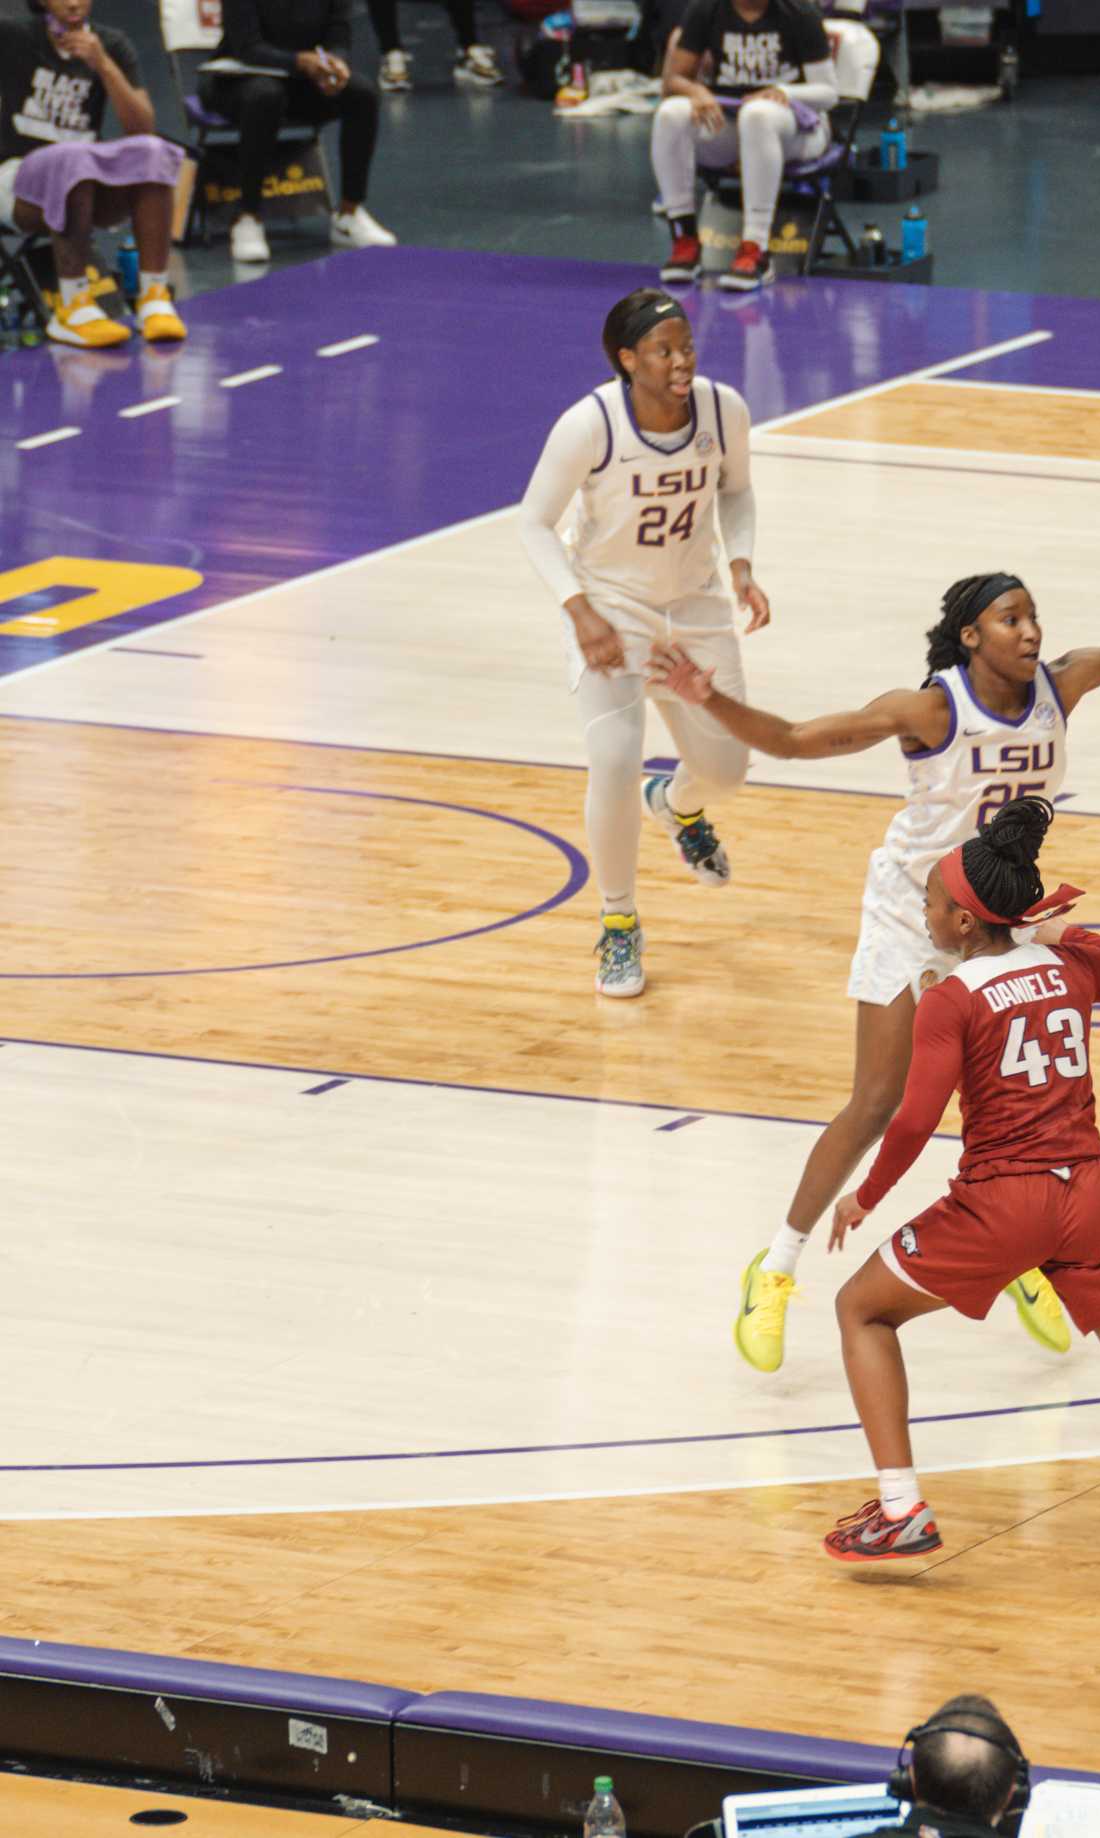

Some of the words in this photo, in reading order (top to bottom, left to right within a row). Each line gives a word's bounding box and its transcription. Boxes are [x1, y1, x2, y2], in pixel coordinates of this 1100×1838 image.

[723, 32, 781, 50] BLACK
[33, 67, 93, 101] BLACK
[632, 465, 707, 497] LSU
[637, 500, 697, 547] 24
[972, 741, 1054, 774] LSU
[982, 968, 1068, 1013] DANIELS
[1000, 1008, 1088, 1087] 43
